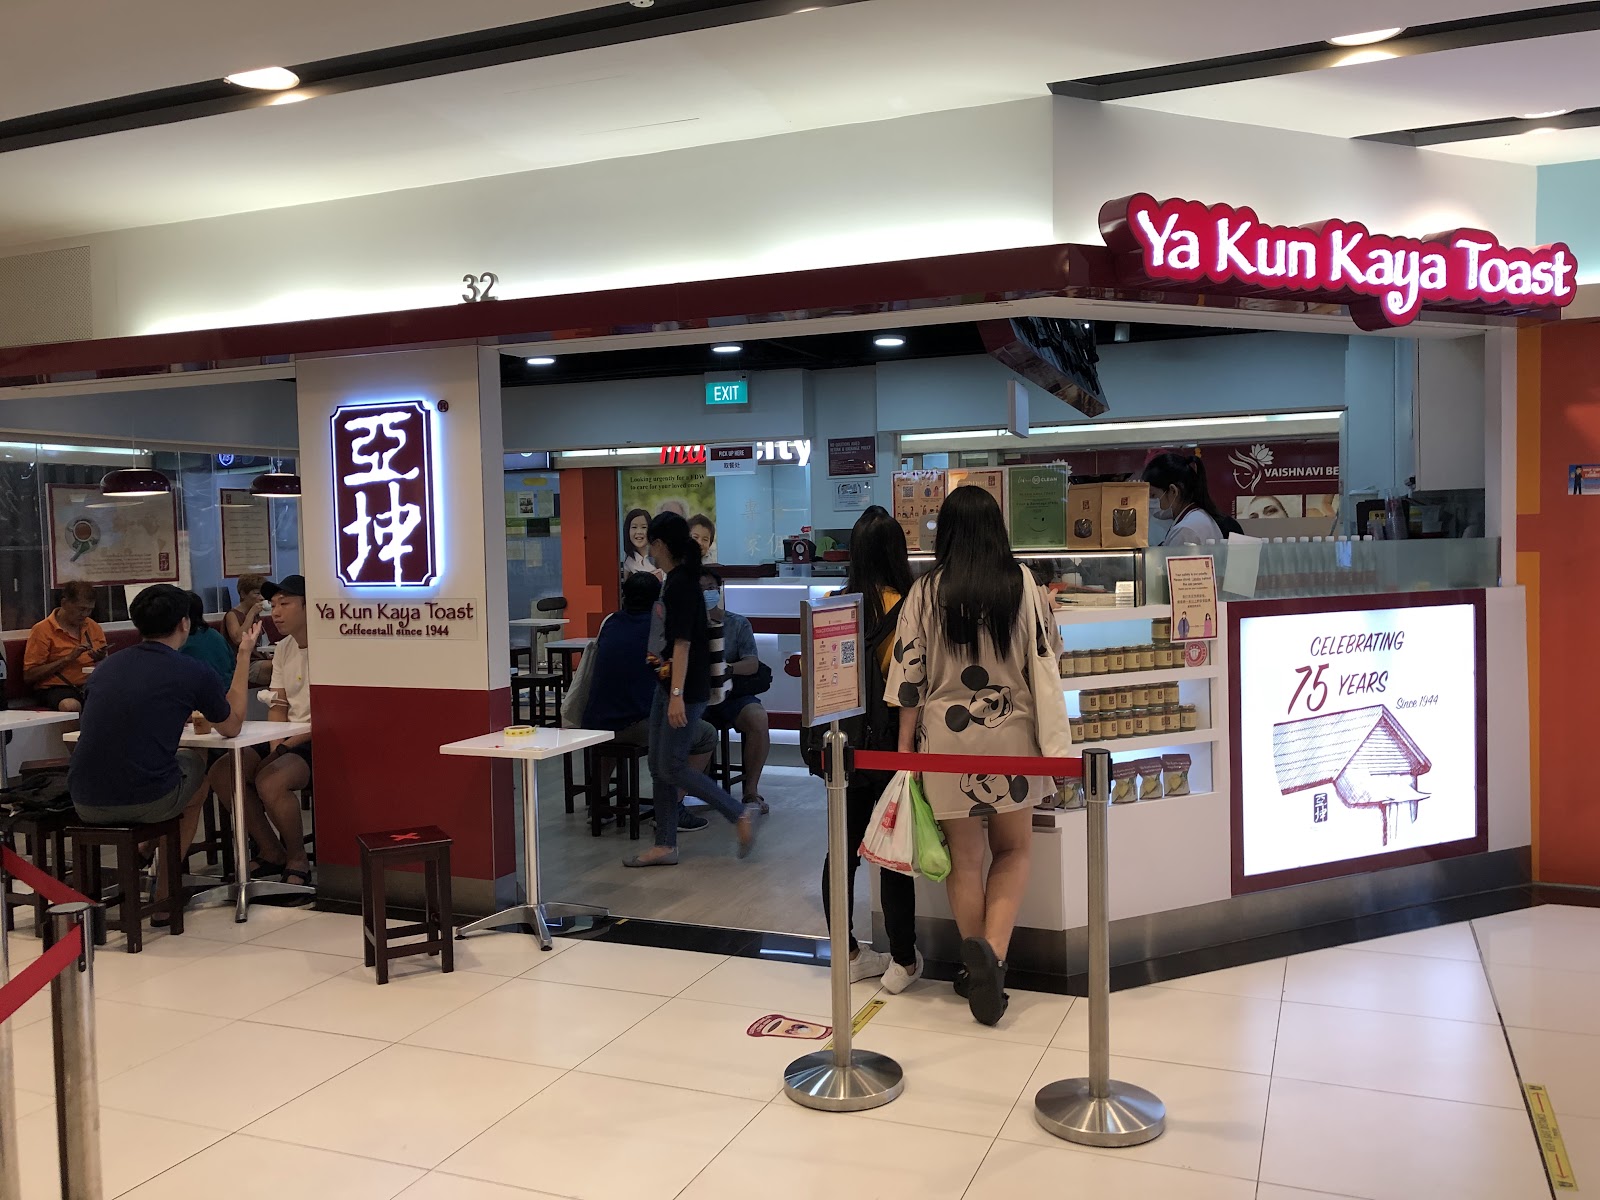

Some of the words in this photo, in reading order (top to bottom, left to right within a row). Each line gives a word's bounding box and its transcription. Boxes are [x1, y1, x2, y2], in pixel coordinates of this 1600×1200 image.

[1137, 209, 1200, 270] Ya
[1216, 218, 1317, 279] Kun
[1330, 229, 1447, 315] Kaya
[1455, 238, 1573, 297] Toast
[462, 271, 499, 303] 32
[714, 385, 739, 401] EXIT
[629, 476, 652, 484] Looking
[652, 475, 675, 483] urgently
[1264, 466, 1323, 477] VAISHNAVI
[315, 602, 336, 620] Ya
[339, 602, 373, 620] Kun
[377, 603, 421, 628] Kaya
[424, 602, 474, 620] Toast
[339, 623, 394, 636] Coffeestall
[396, 626, 422, 636] since
[425, 624, 449, 636] 1944
[1310, 630, 1405, 657] CELEBRATING
[1287, 662, 1330, 715] 75
[1338, 670, 1389, 697] YEARS
[1395, 697, 1418, 709] Since
[1419, 694, 1439, 708] 1944
